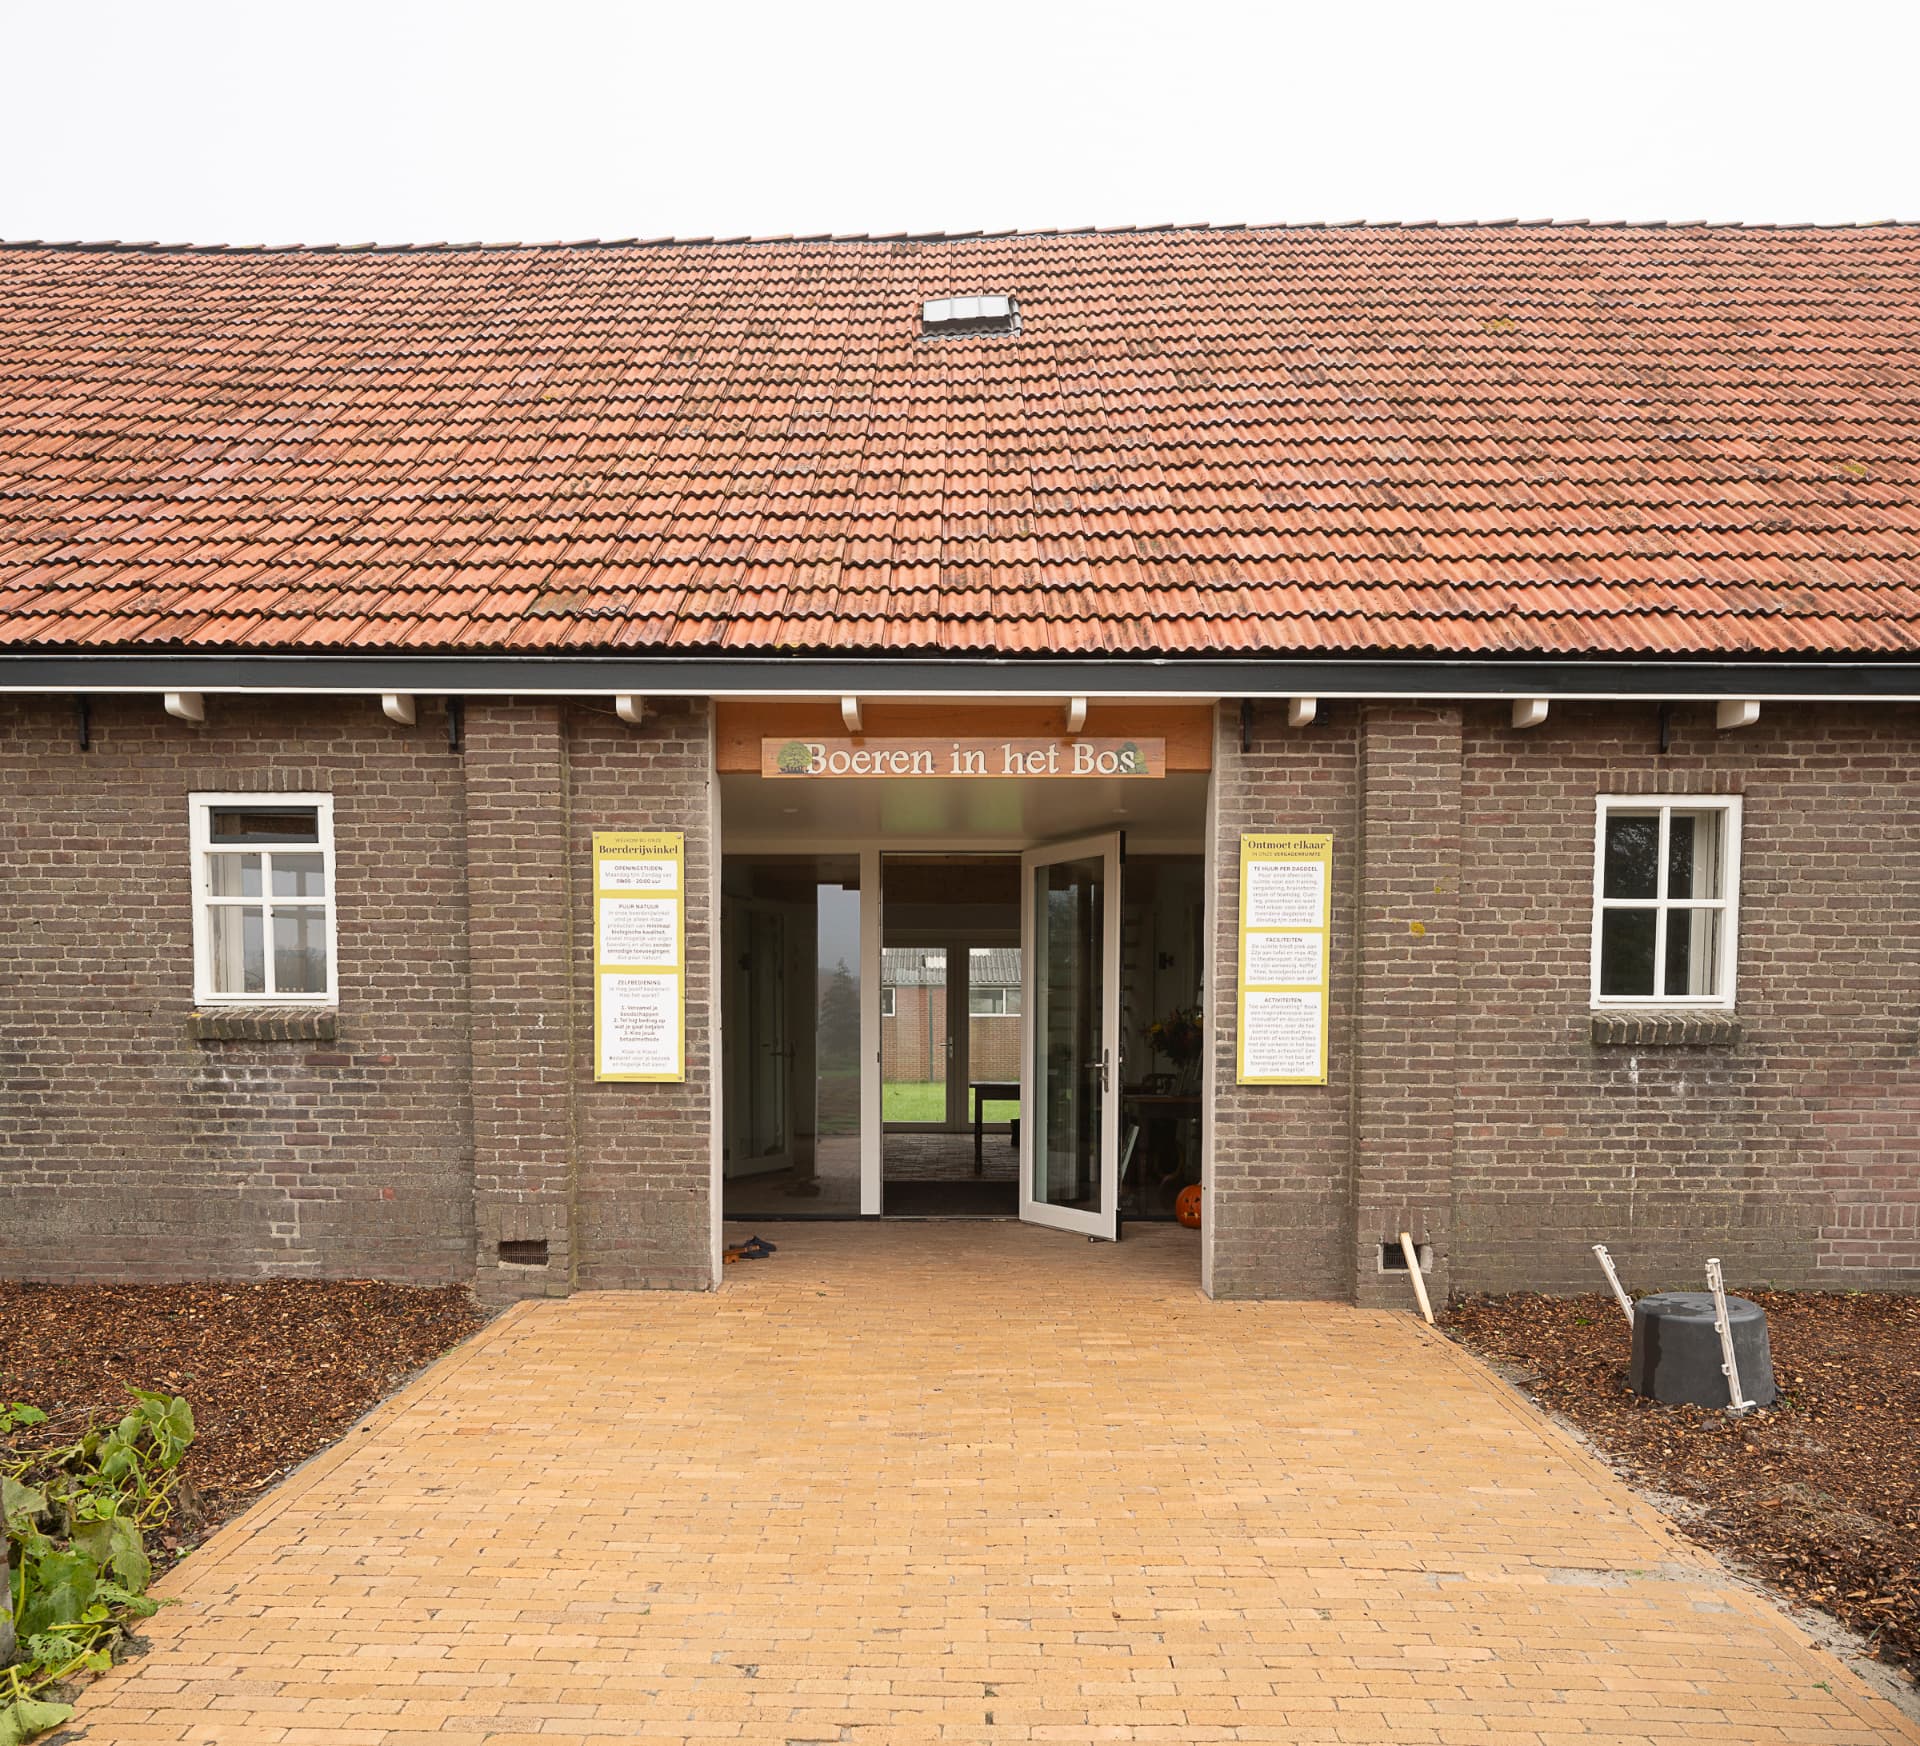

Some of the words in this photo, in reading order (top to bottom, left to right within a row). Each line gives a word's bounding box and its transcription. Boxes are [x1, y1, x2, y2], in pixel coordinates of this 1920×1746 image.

[805, 743, 934, 775] Boeren
[950, 743, 987, 775] in
[1001, 744, 1059, 775] het
[1072, 743, 1136, 775] Bos
[1248, 840, 1291, 849] Ontmoet
[1293, 840, 1326, 849] elkaar
[599, 845, 678, 855] Boerderijwinkel
